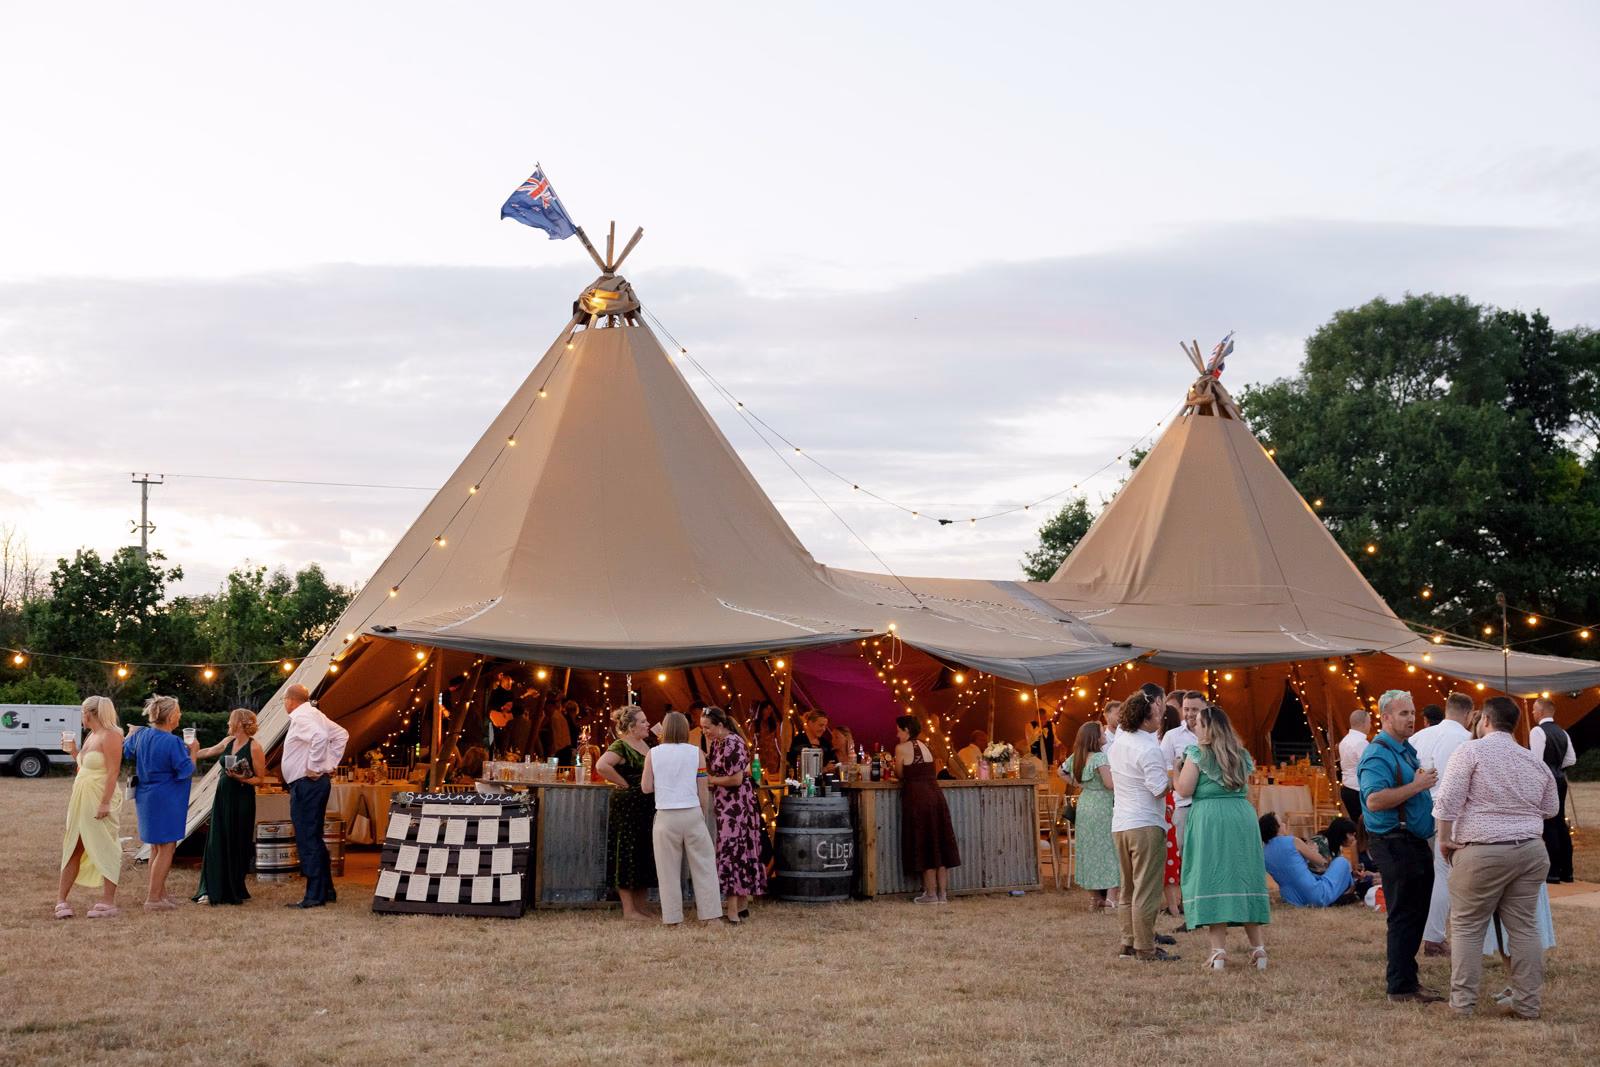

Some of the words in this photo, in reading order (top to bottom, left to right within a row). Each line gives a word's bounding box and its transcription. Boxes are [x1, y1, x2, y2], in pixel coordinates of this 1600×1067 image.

[406, 791, 476, 804] Seating
[479, 792, 518, 804] Pla
[816, 840, 853, 859] CIDER
